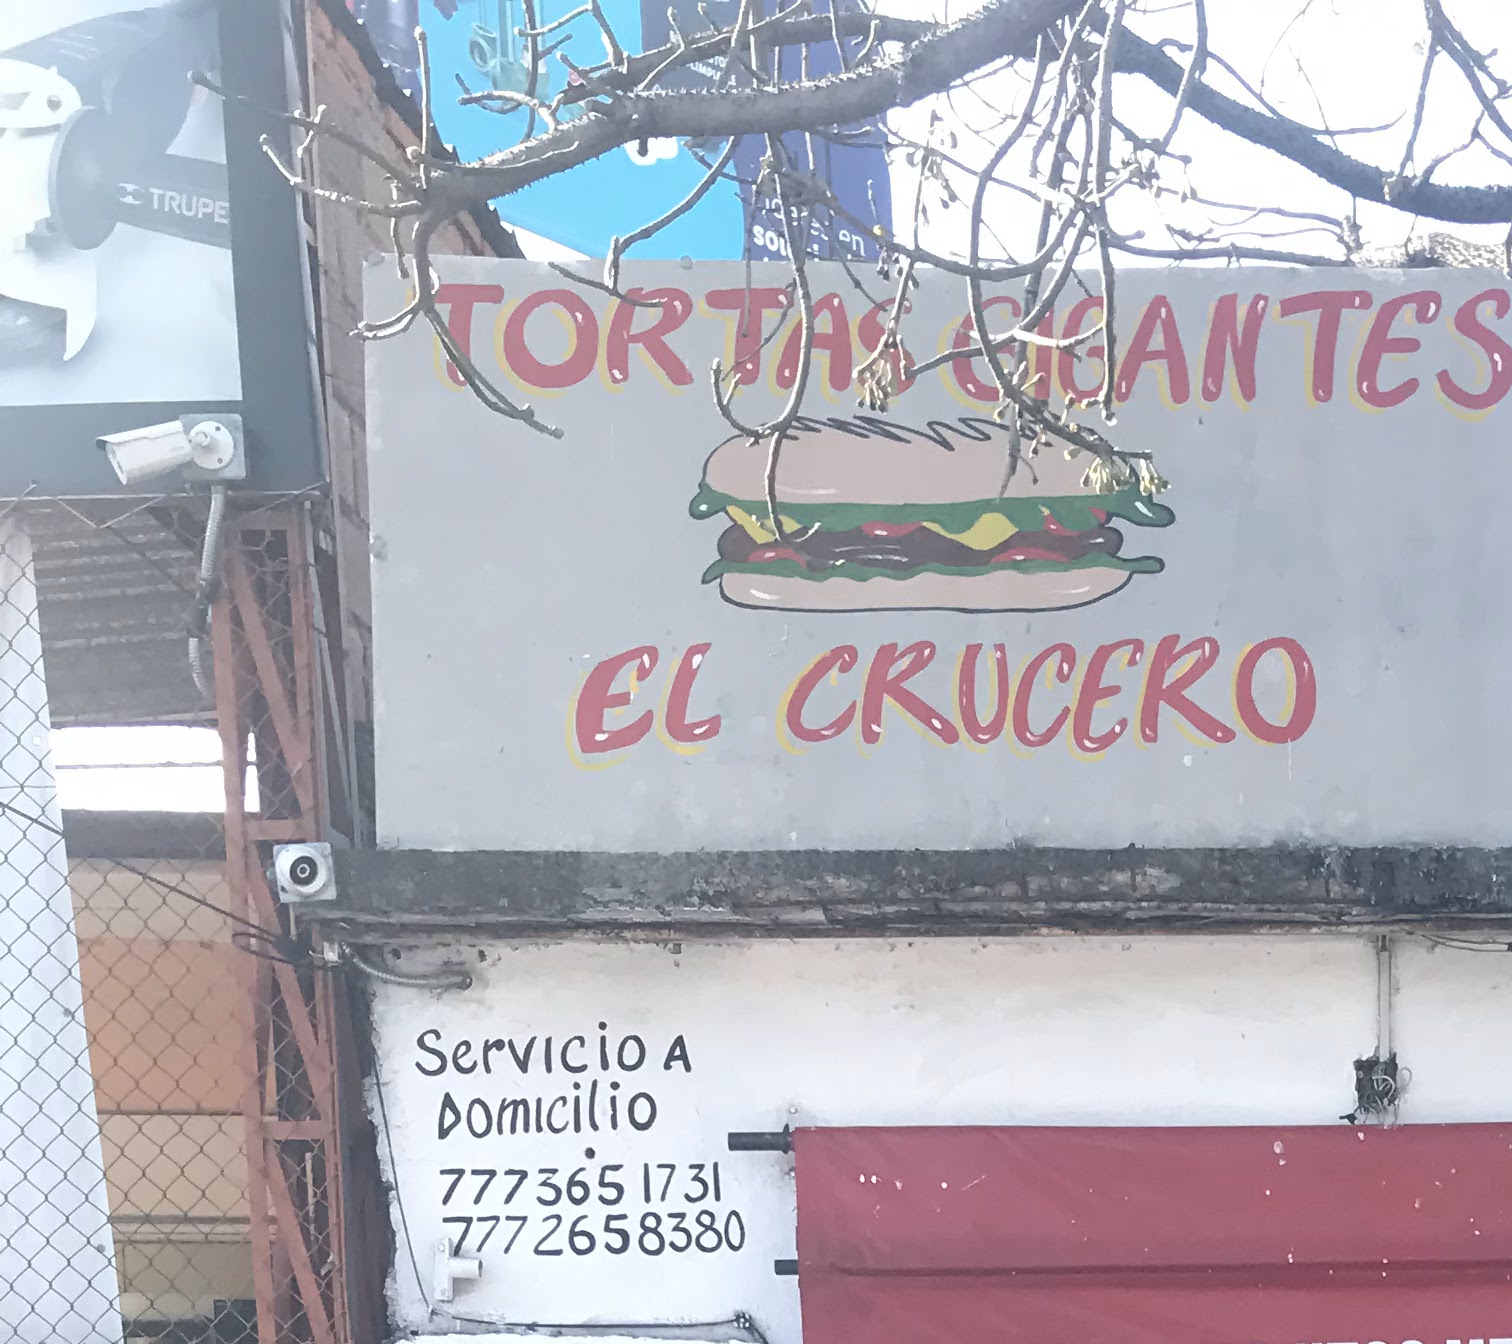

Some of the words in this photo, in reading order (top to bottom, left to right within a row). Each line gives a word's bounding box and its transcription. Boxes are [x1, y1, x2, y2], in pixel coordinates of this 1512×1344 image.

[430, 282, 916, 396] TORTAS
[571, 641, 722, 764] EL
[780, 634, 1318, 758] CRUCERO
[415, 1021, 646, 1076] Servicio
[663, 1034, 692, 1073] A
[437, 1079, 657, 1140] Domicilio
